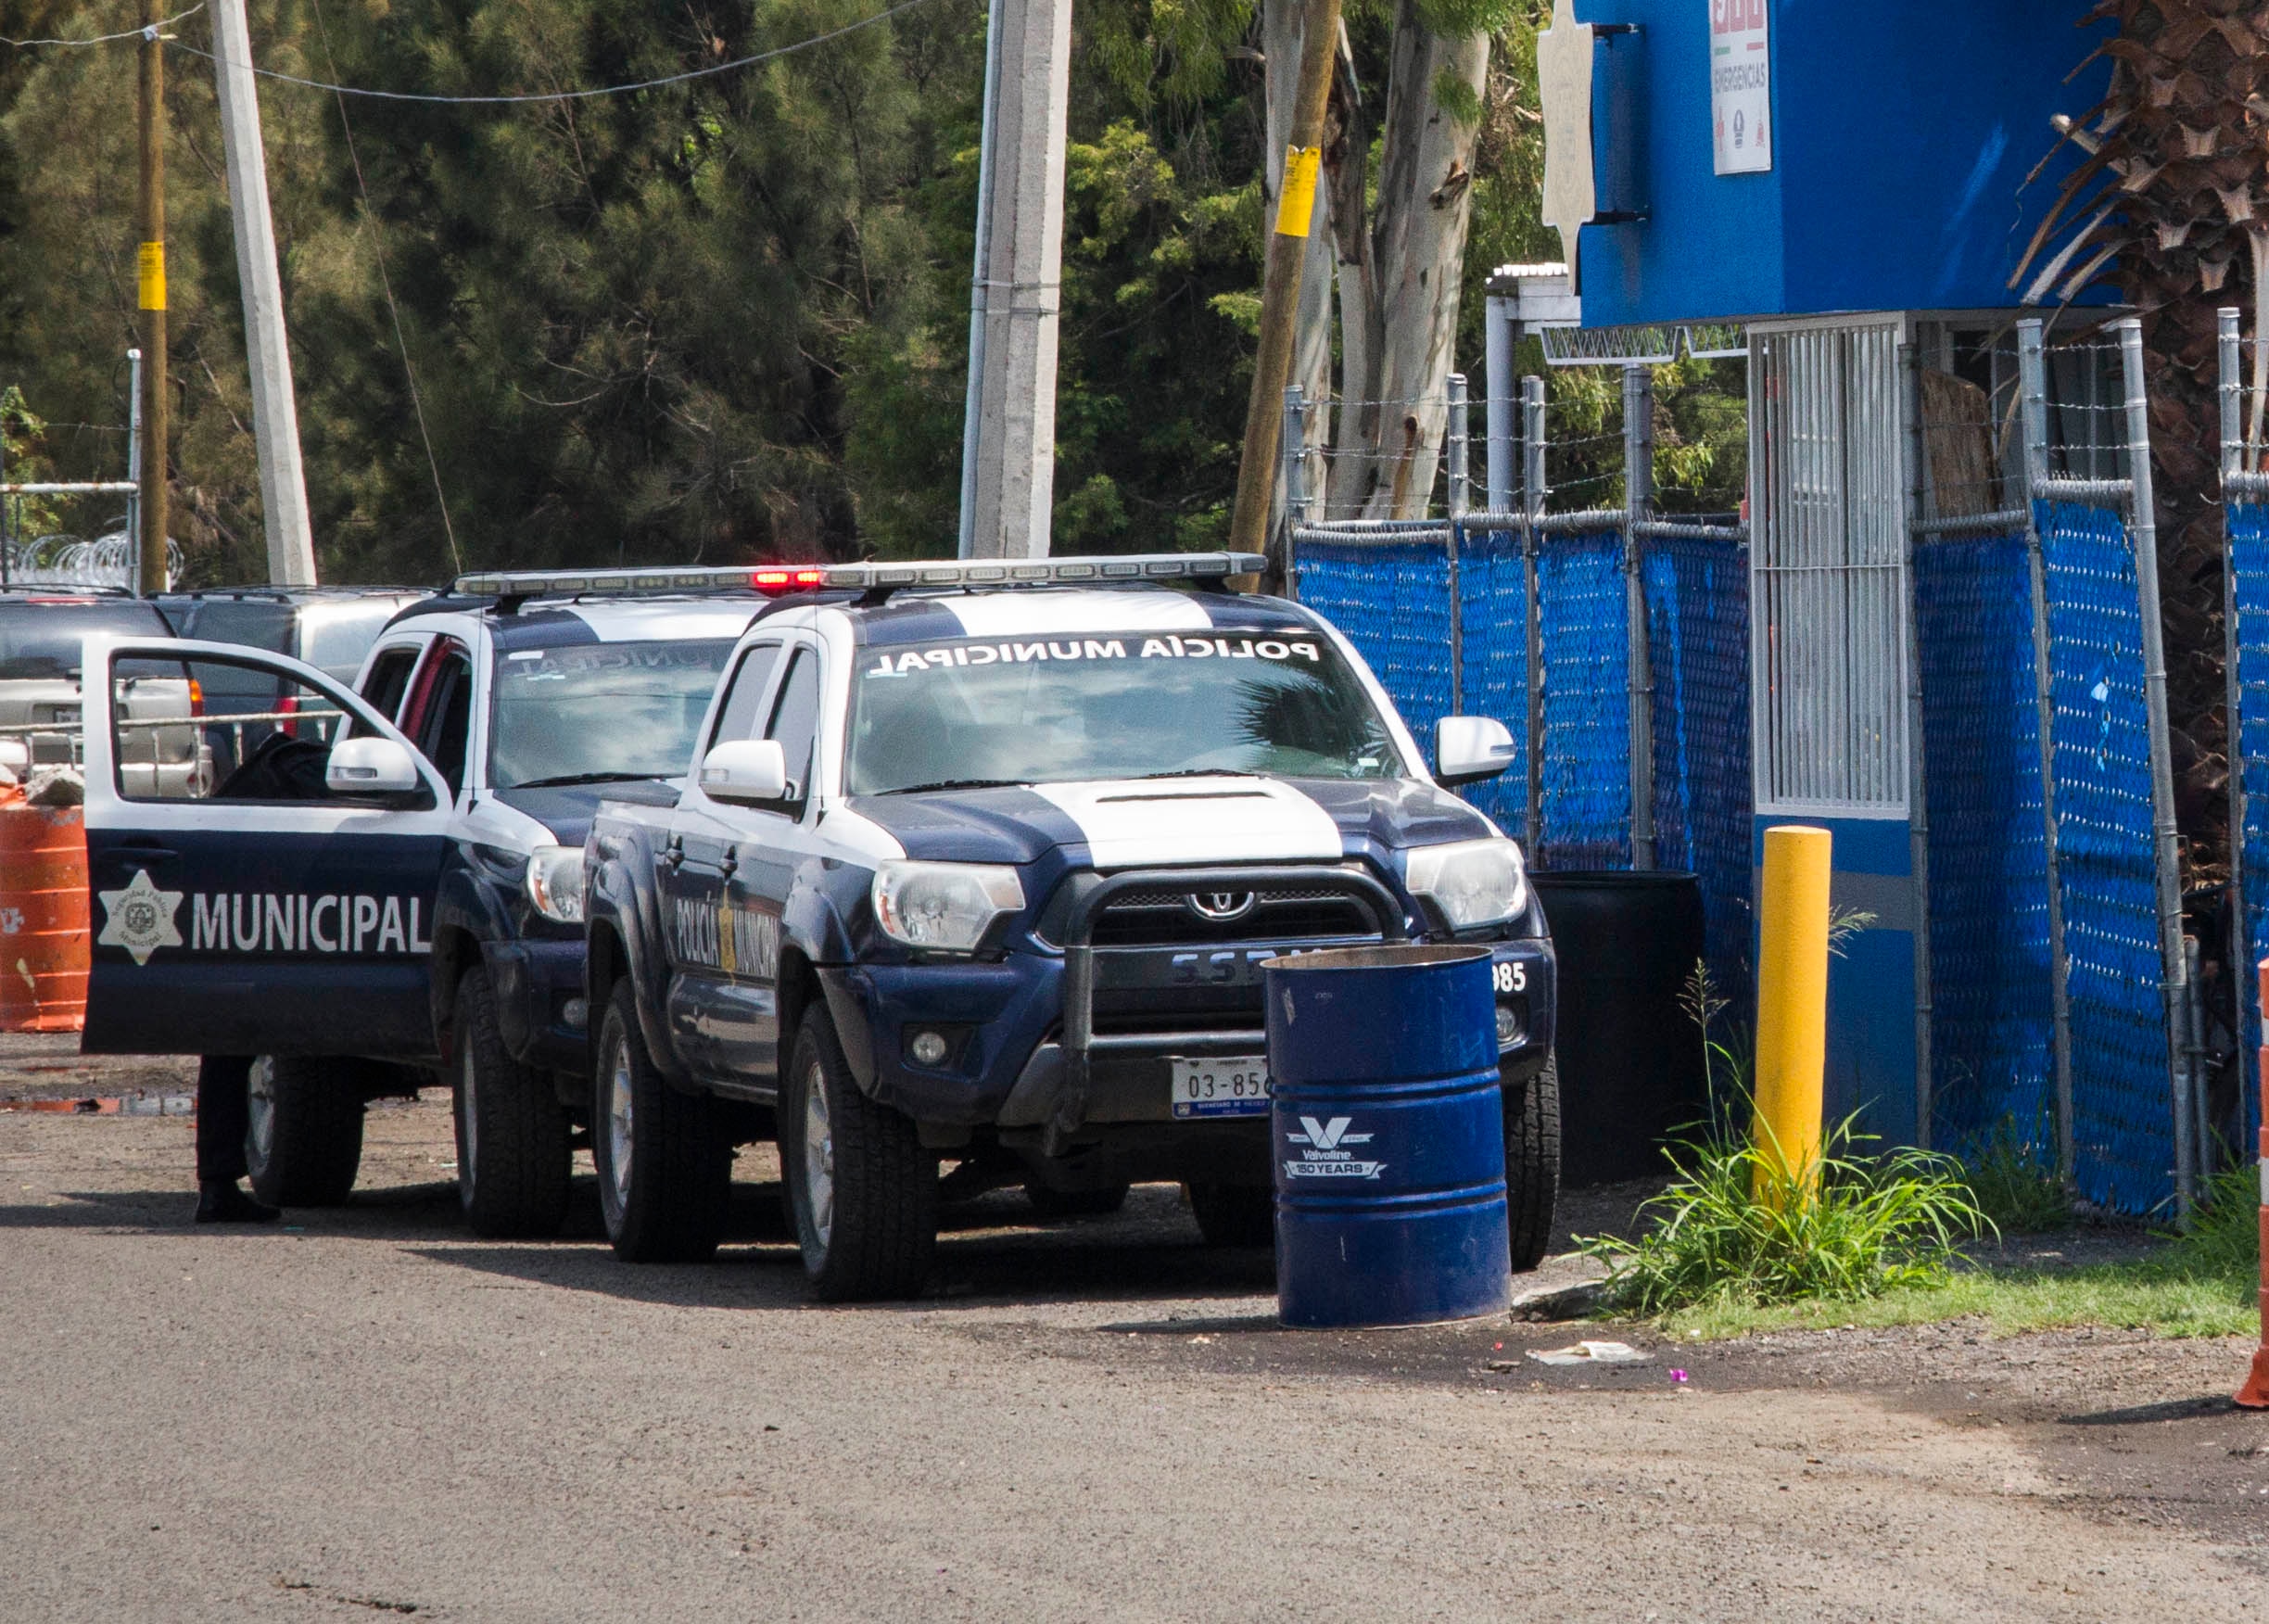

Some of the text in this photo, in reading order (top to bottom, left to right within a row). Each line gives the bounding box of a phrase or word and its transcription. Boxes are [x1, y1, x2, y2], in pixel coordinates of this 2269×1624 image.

[192, 893, 432, 953] MUNICIPAL
[1302, 1149, 1352, 1161] Valvoline
[1316, 1164, 1363, 1174] YEARS
